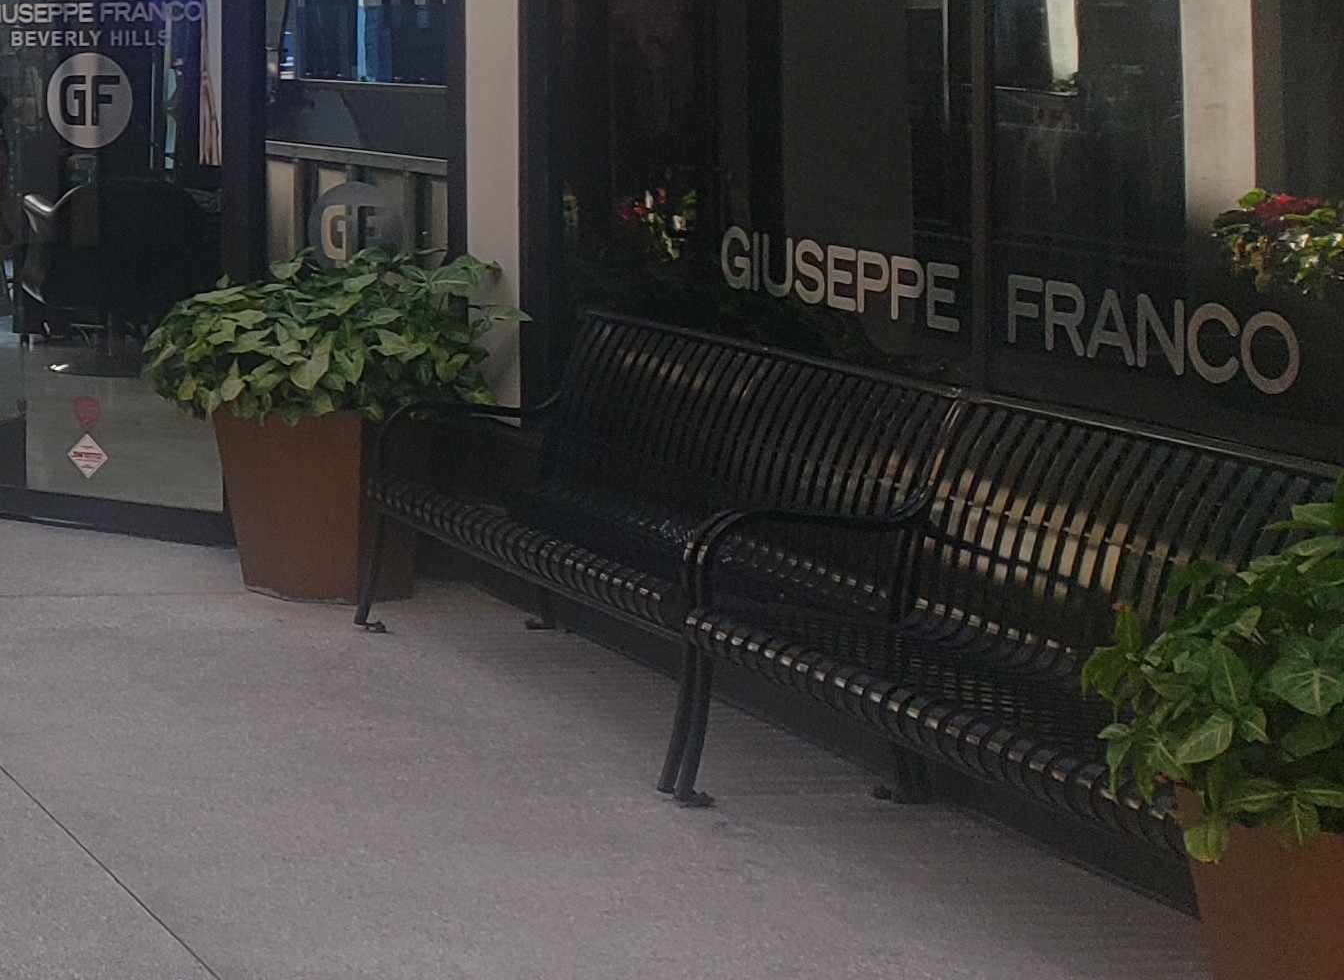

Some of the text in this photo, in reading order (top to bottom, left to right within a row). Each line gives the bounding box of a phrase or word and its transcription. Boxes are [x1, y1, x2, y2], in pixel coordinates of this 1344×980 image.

[100, 1, 202, 22] FRANCO
[11, 30, 170, 47] BEVERLY HILLS
[59, 75, 120, 127] GF
[721, 225, 1300, 395] GIUSEPPE FRANCO
